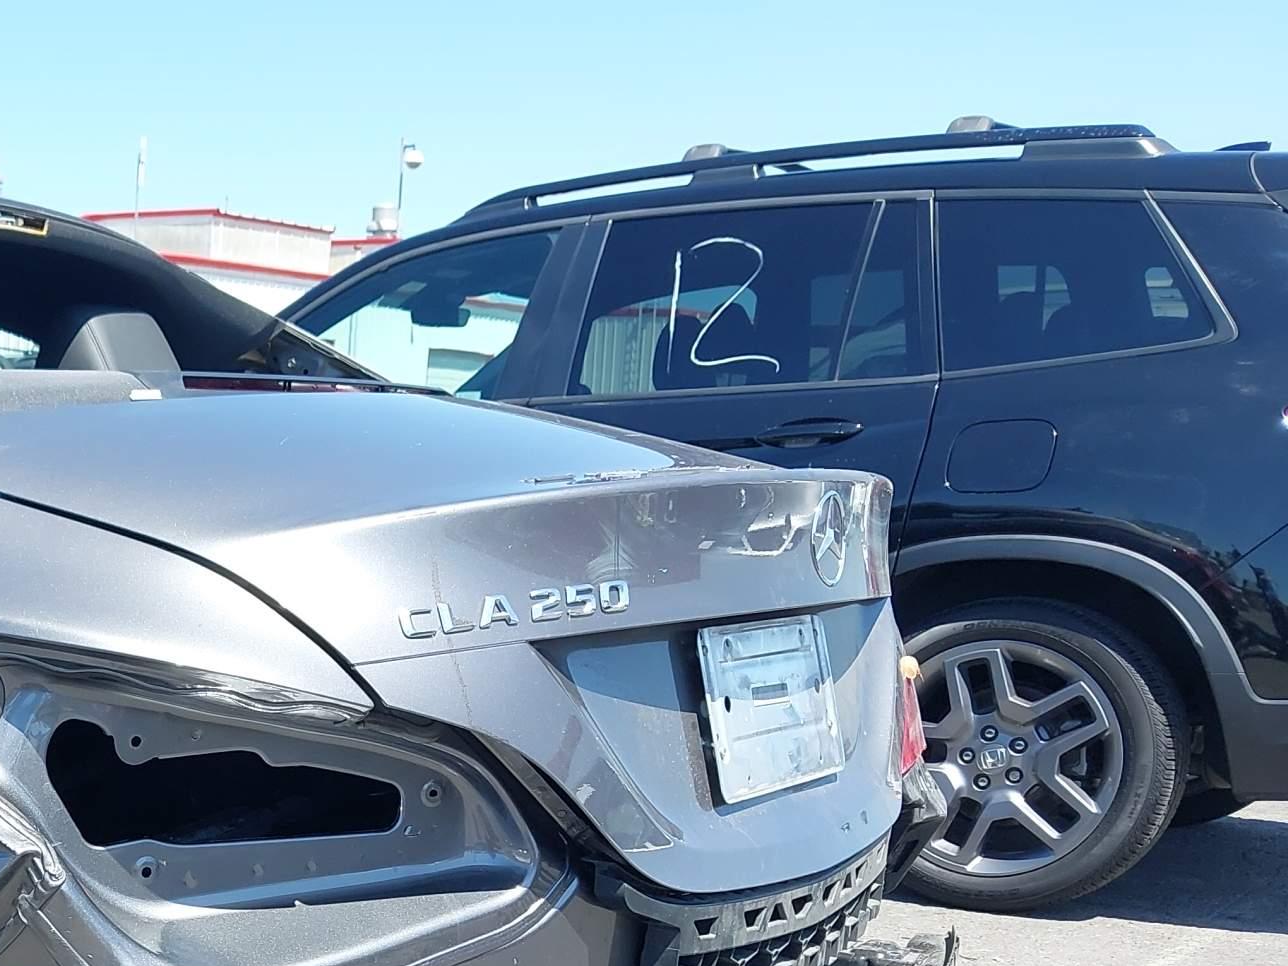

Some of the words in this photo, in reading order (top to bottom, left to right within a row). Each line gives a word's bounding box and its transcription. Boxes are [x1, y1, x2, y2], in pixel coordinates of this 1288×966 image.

[666, 236, 781, 375] 12
[398, 593, 520, 640] CLA
[528, 579, 631, 624] 250
